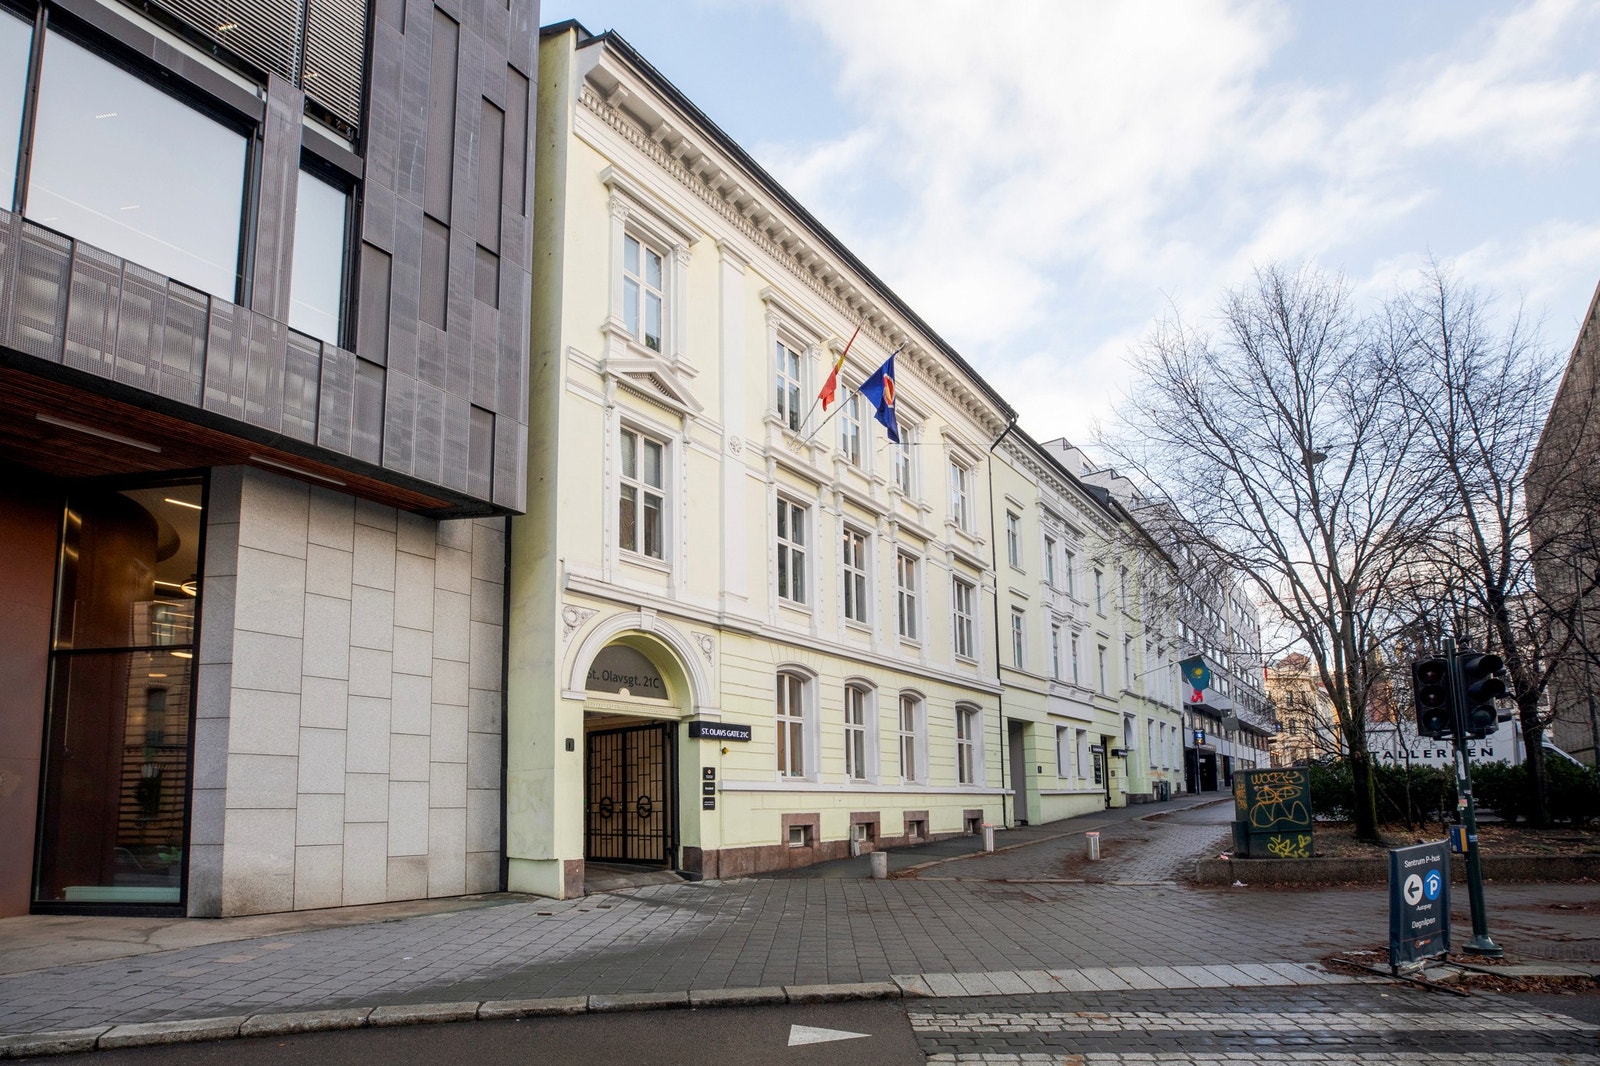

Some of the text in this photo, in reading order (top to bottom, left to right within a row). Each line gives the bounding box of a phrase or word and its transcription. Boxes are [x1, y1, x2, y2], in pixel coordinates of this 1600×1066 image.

[602, 670, 641, 687] Olavsgt.
[643, 676, 659, 688] 21C
[710, 728, 726, 737] OLAVS
[726, 730, 739, 738] GATE
[1369, 748, 1494, 760] TALLEREN
[1404, 855, 1440, 868] Sentrum P-hus
[1430, 880, 1438, 895] P
